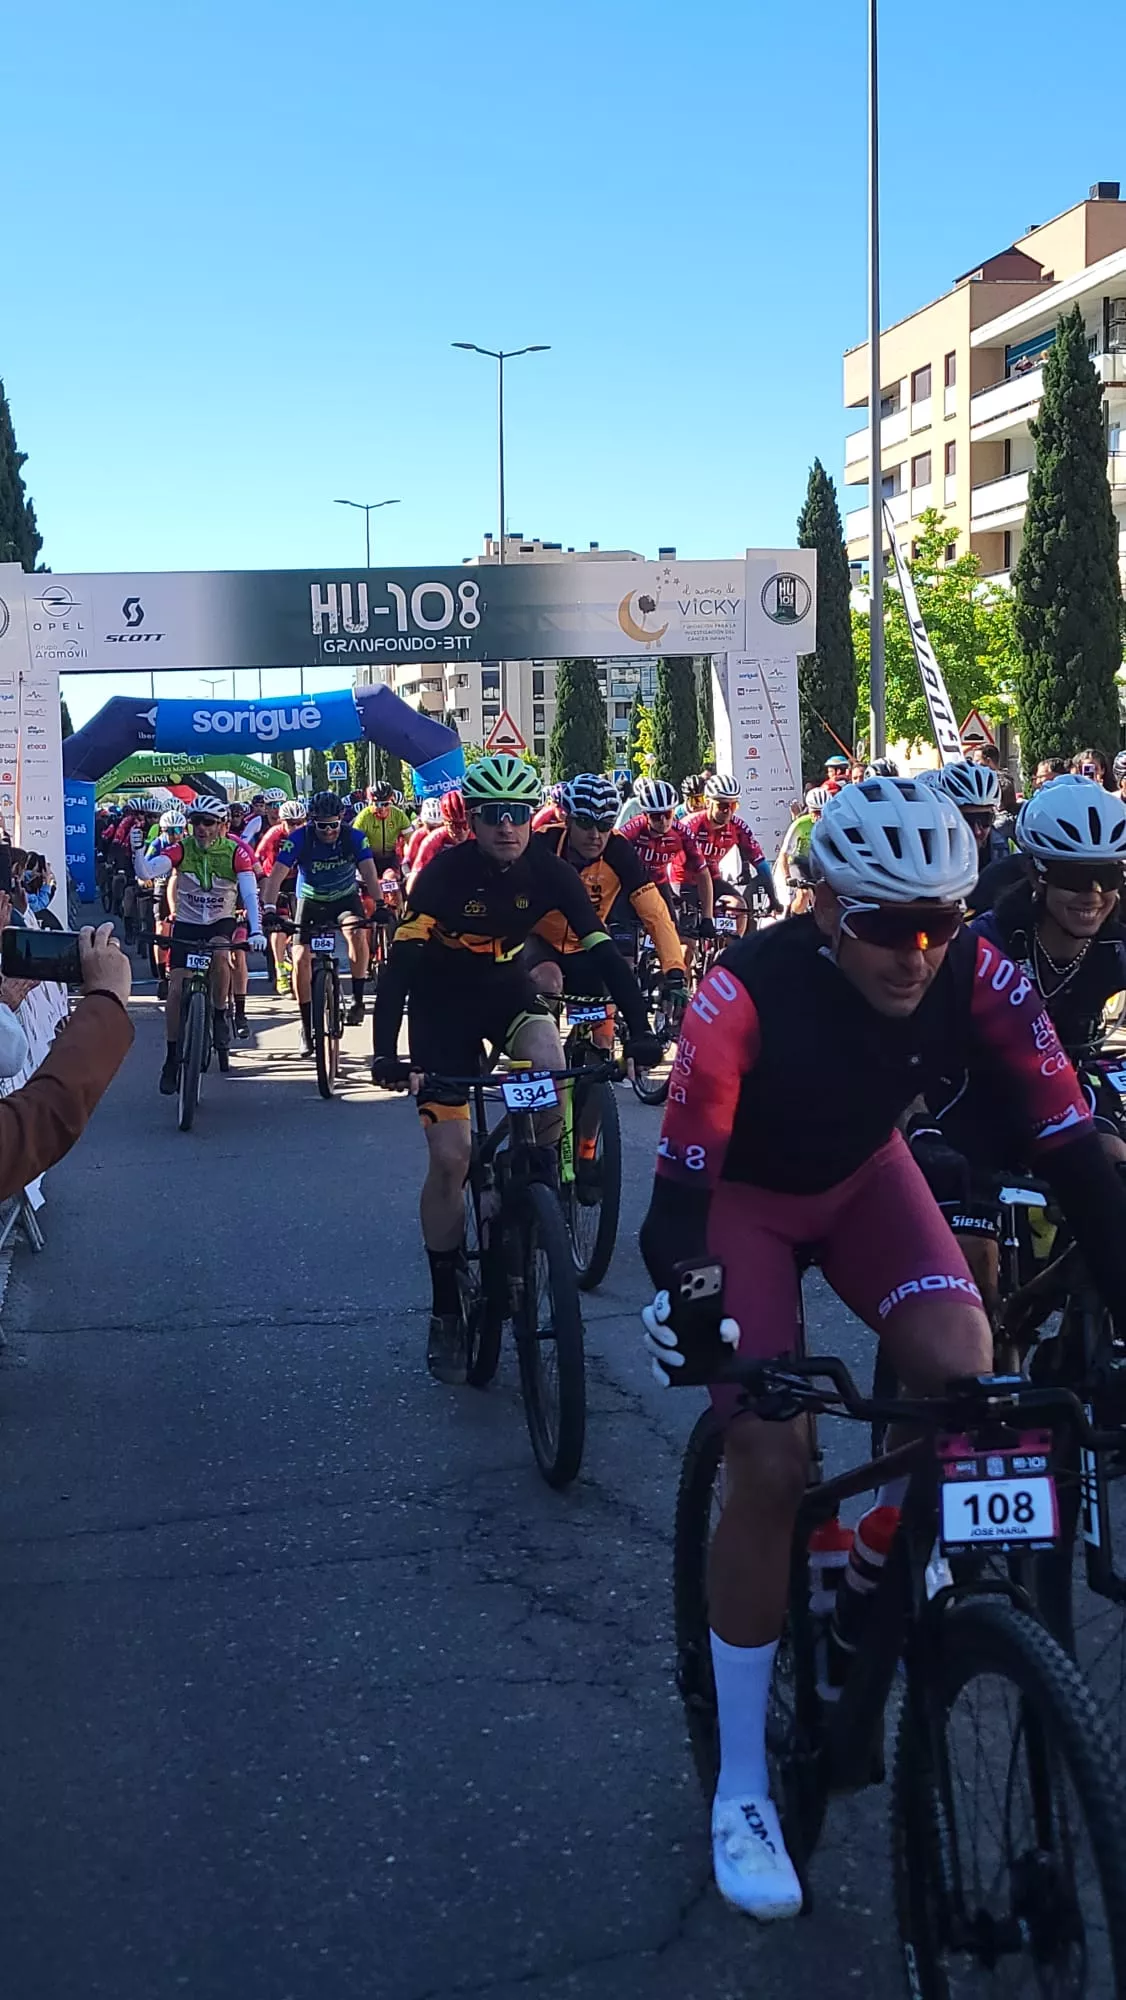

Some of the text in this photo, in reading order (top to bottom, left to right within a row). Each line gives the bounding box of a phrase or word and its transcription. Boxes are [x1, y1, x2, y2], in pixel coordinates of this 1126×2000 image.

[310, 581, 481, 635] HU-108
[33, 622, 85, 631] OPEL
[104, 633, 166, 643] SCOTT
[977, 948, 1033, 1006] 108
[691, 971, 737, 1025] HU
[512, 1085, 548, 1101] 334
[950, 1215, 996, 1232] Siesta
[962, 1491, 1035, 1526] 108
